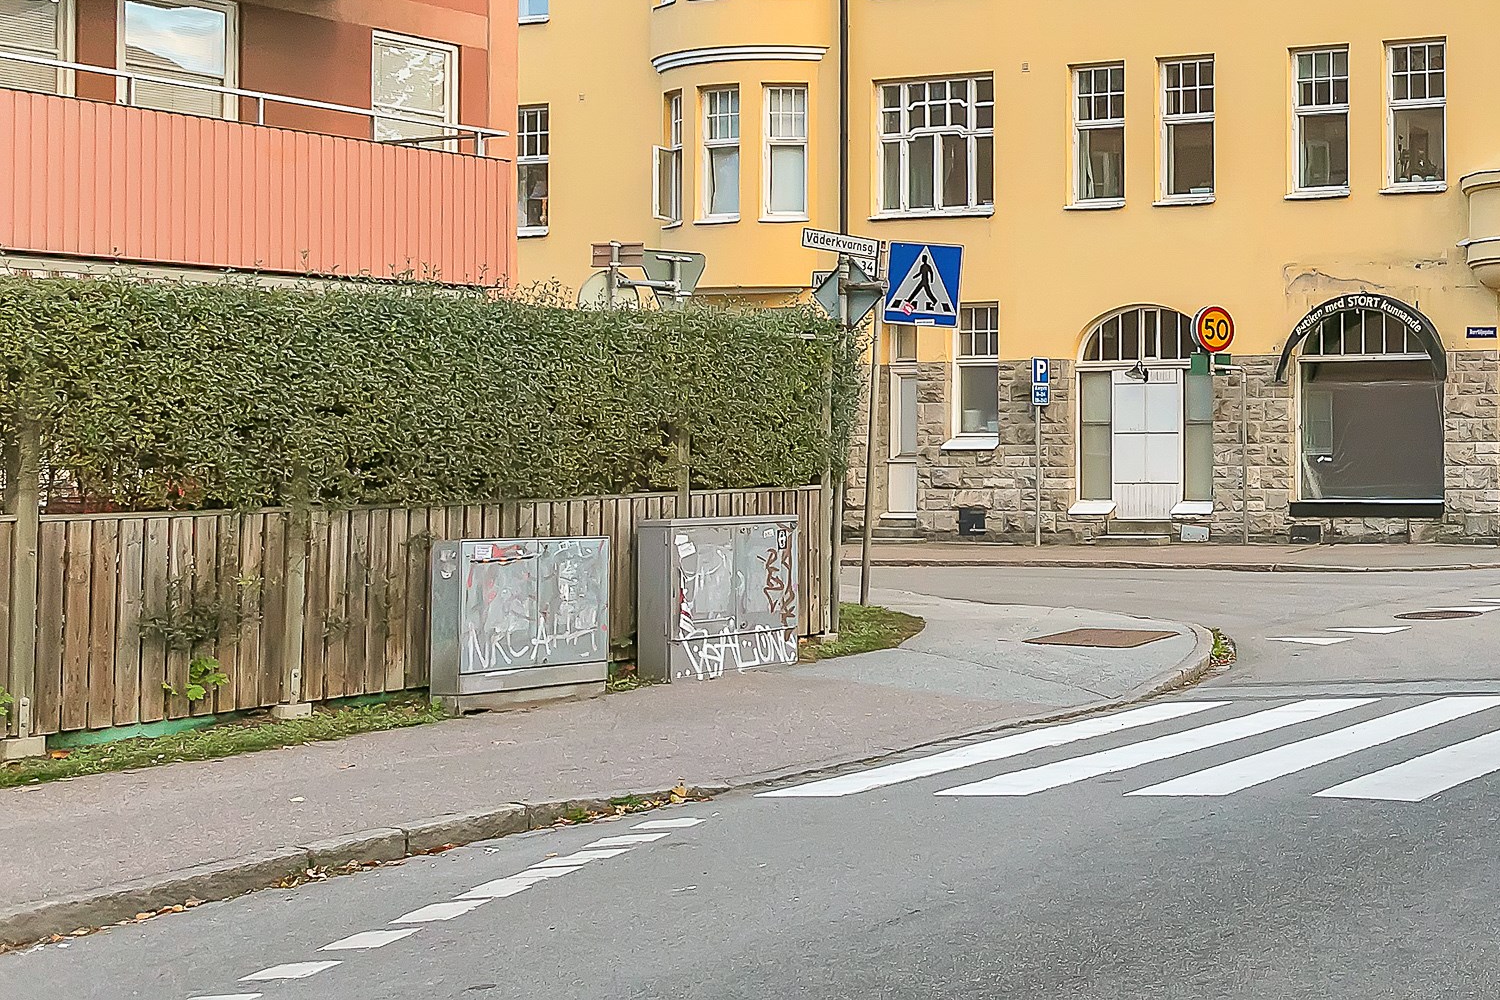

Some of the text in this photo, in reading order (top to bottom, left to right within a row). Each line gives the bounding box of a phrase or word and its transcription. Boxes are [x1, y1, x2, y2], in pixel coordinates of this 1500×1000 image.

[806, 231, 875, 255] Väderkvarnsg.
[1324, 298, 1345, 314] med
[1347, 295, 1381, 308] STORT
[1380, 299, 1422, 333] kunnande
[1204, 318, 1229, 341] 50
[1036, 360, 1047, 382] P
